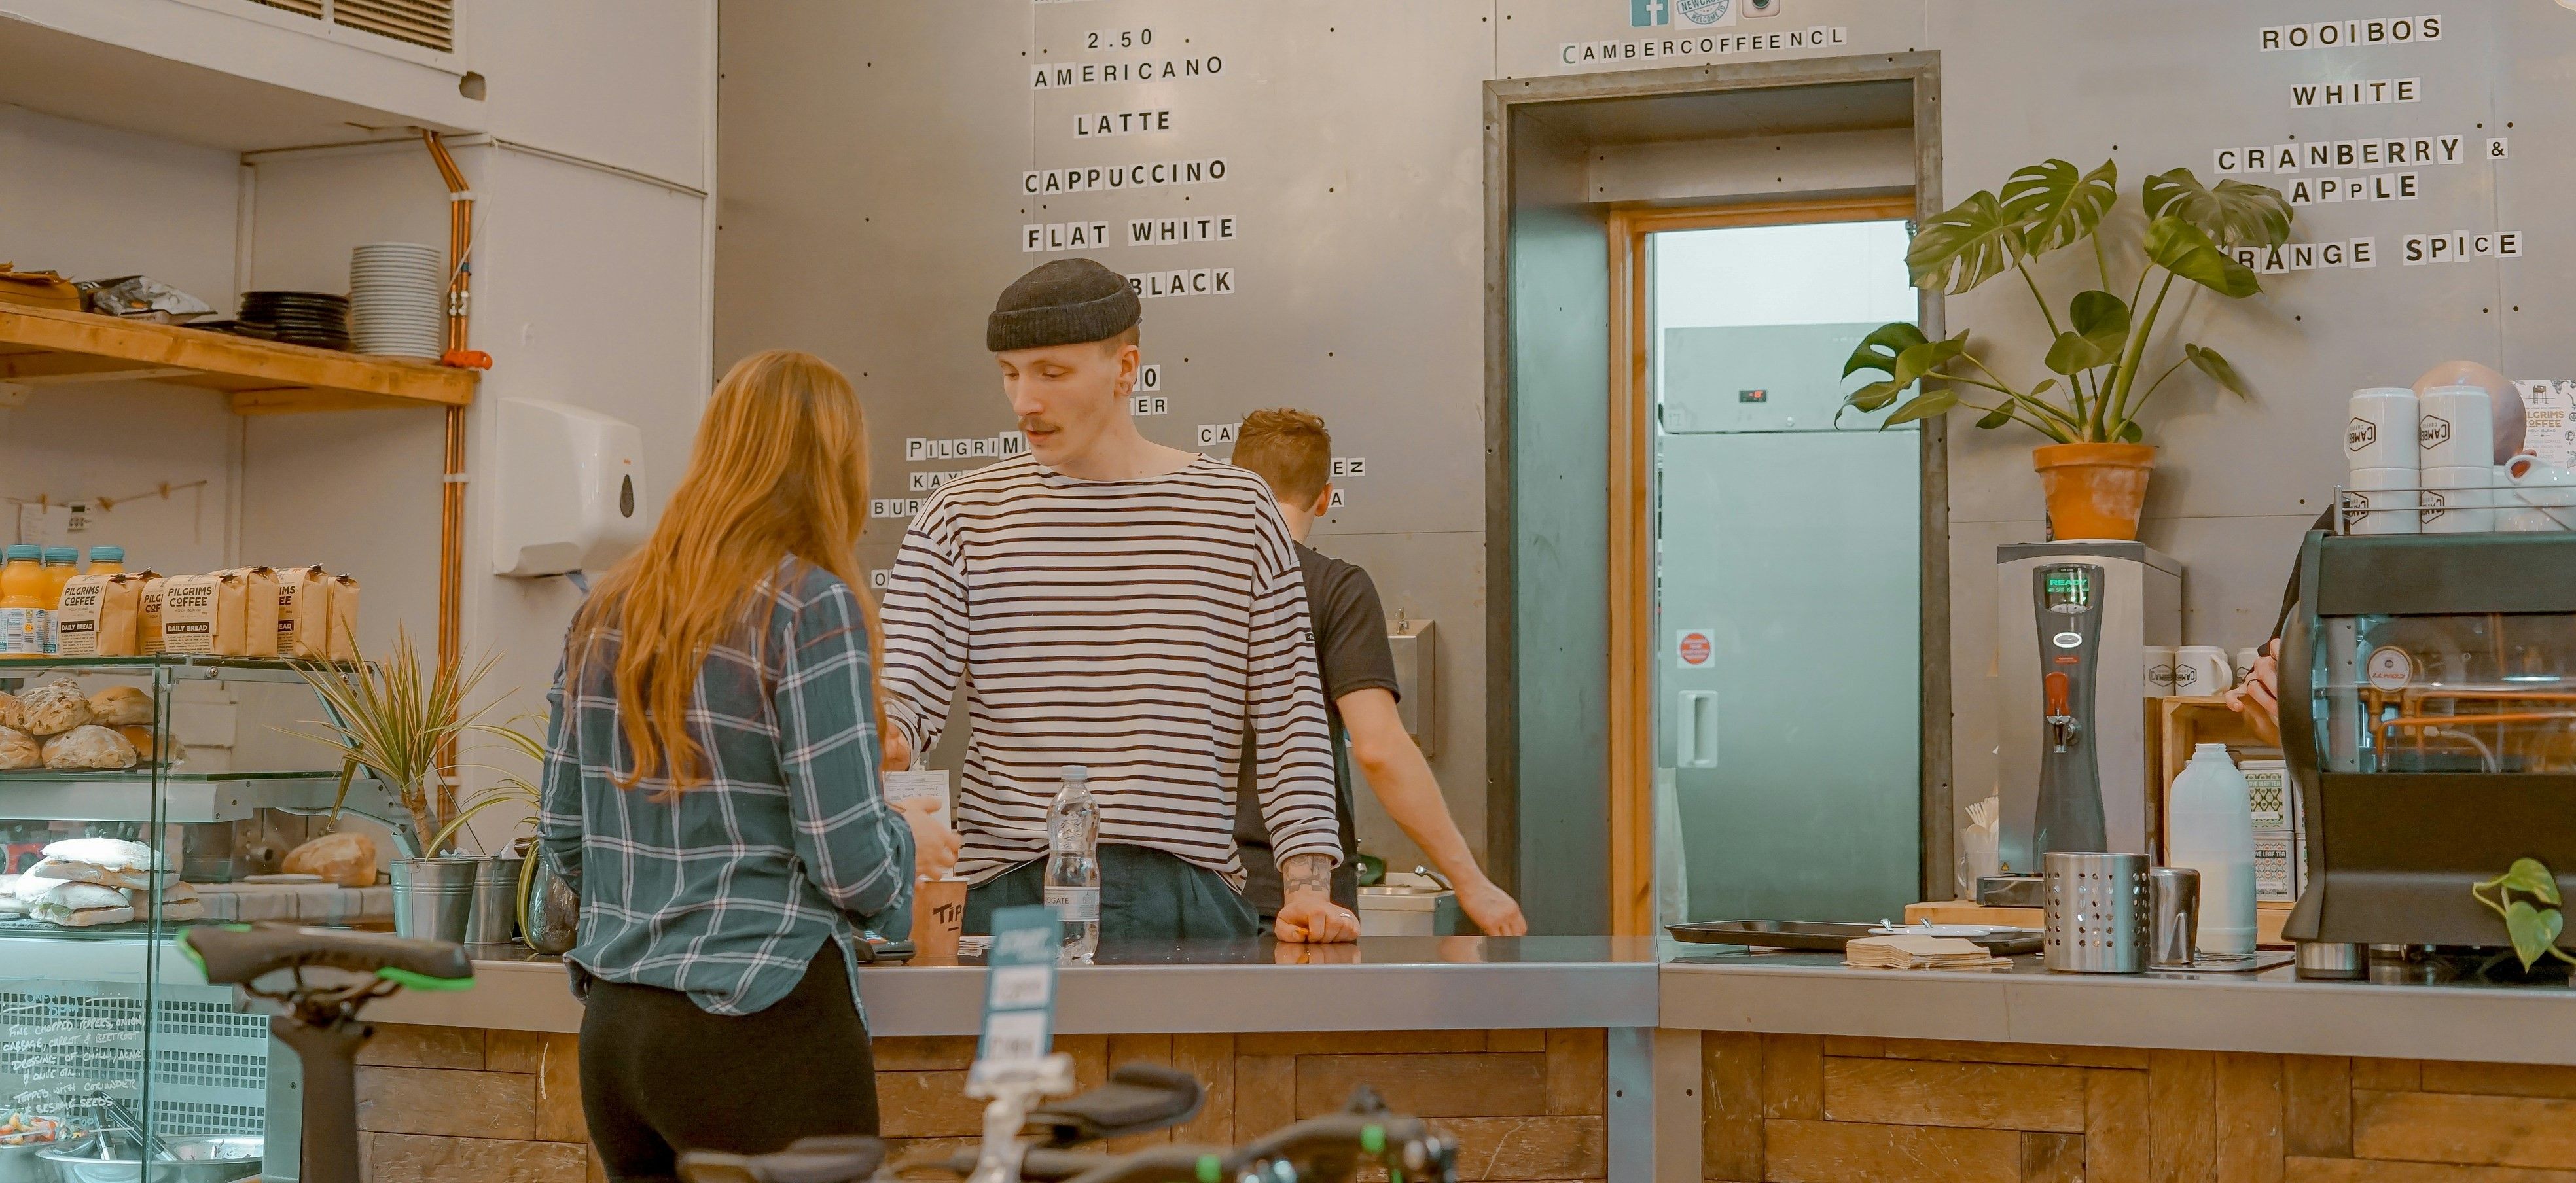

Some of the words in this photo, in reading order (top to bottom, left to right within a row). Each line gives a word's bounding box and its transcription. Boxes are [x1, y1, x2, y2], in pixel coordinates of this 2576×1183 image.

[1691, 12, 1719, 23] WELCOME
[1087, 29, 1153, 49] 2.50
[2263, 18, 2440, 50] ROOIBOS
[1562, 29, 1843, 64] CAMBERCOFFEENCL
[1034, 56, 1223, 88] AMERICANO
[2293, 81, 2414, 105] WHITE
[1078, 111, 1170, 135] LATTE
[2218, 138, 2459, 171] CRANBERRY
[2491, 141, 2505, 156] &
[1025, 160, 1226, 193] CAPPUCCINO
[2293, 175, 2416, 203] APPLE
[1029, 225, 1107, 249] FLAT
[1132, 219, 1233, 241] WHITE
[2406, 234, 2517, 261] SPICE
[1130, 272, 1231, 296] BLACK
[1129, 399, 1165, 413] ER
[1201, 427, 1241, 443] CA
[910, 436, 1031, 457] PILGRIM
[874, 501, 918, 515] BUR
[65, 586, 99, 596] PILGRIMS
[168, 586, 212, 596] PILGRIMS
[279, 586, 296, 595] IMS
[65, 596, 95, 607] COFFEE
[170, 597, 207, 607] COFFEE
[9, 1023, 28, 1038] FINE
[35, 1021, 73, 1035] CHOPPED
[49, 1034, 81, 1047] CARROT
[95, 1031, 139, 1044] BEETROOT
[12, 1055, 57, 1071] DRESSING
[65, 1052, 78, 1062] OF
[33, 1068, 55, 1080] OLIVE
[13, 1089, 50, 1103] TOPPED
[53, 1082, 76, 1095] WITH
[80, 1097, 113, 1108] SEEDS
